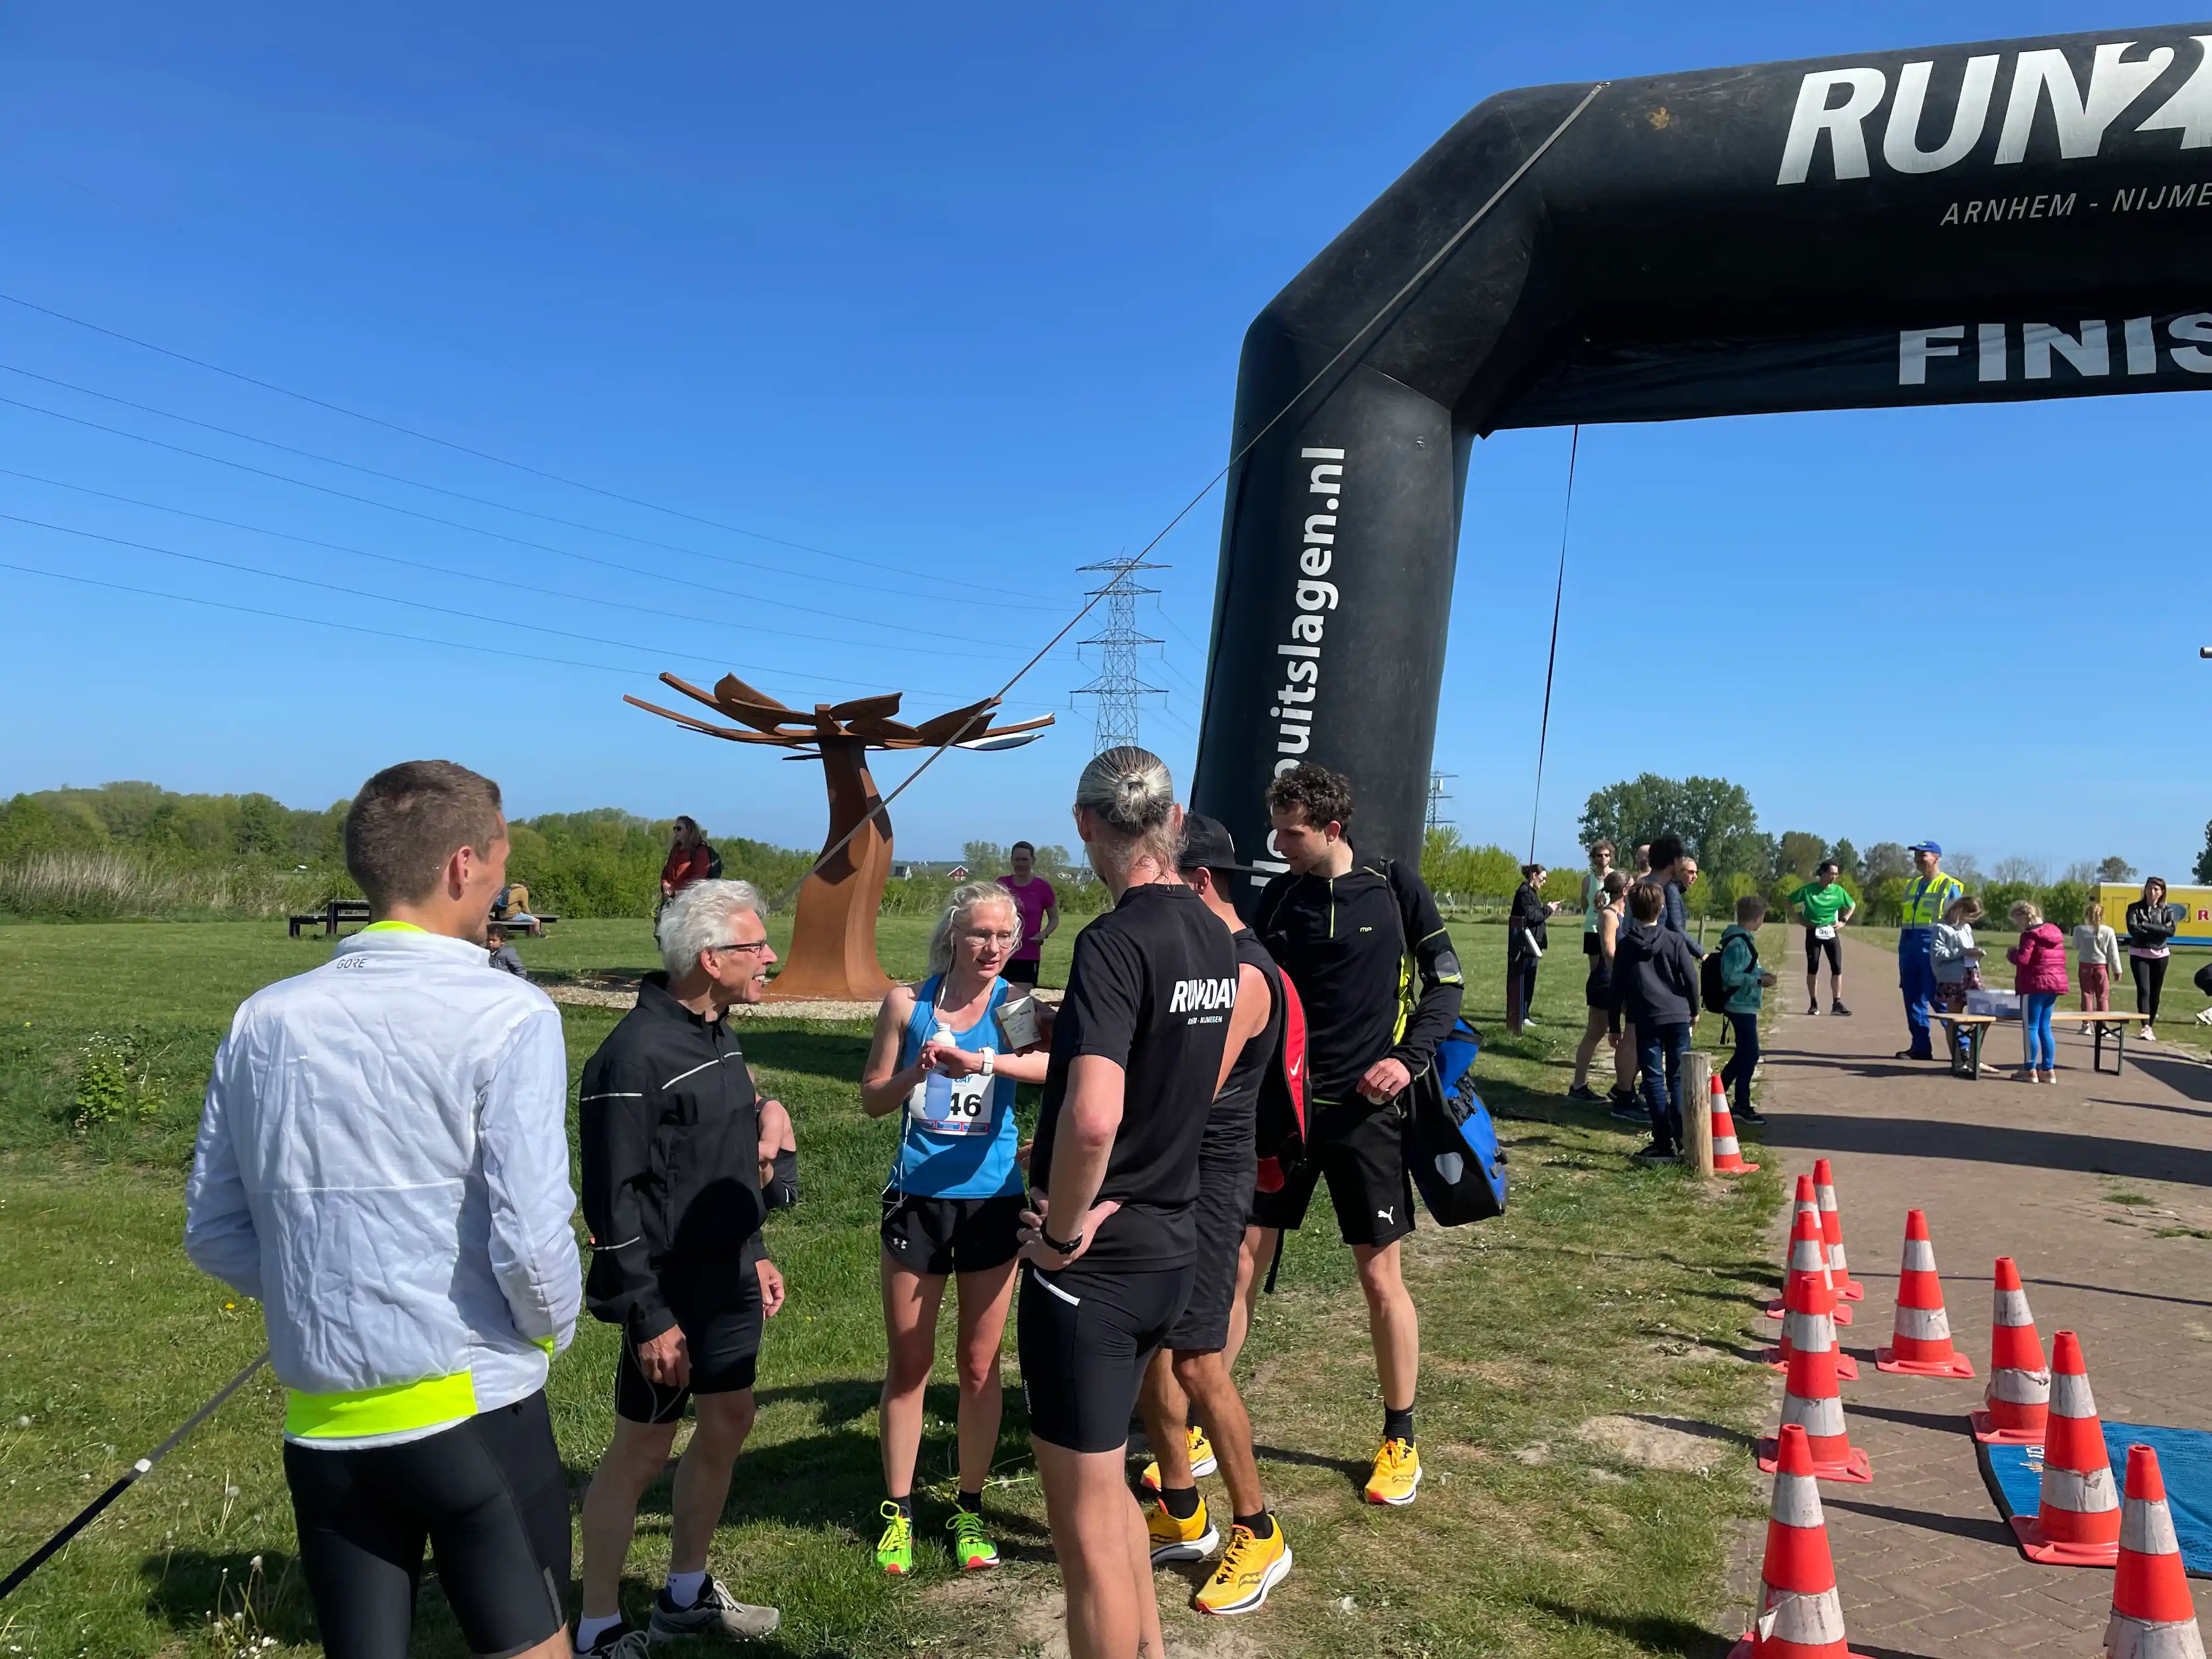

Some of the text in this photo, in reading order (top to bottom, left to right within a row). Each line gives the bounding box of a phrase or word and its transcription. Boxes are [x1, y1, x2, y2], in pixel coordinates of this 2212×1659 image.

[1940, 193, 2077, 226] ARNHEM
[2112, 182, 2212, 212] NIJME
[1899, 312, 2212, 385] FINIS
[336, 958, 368, 969] GORE
